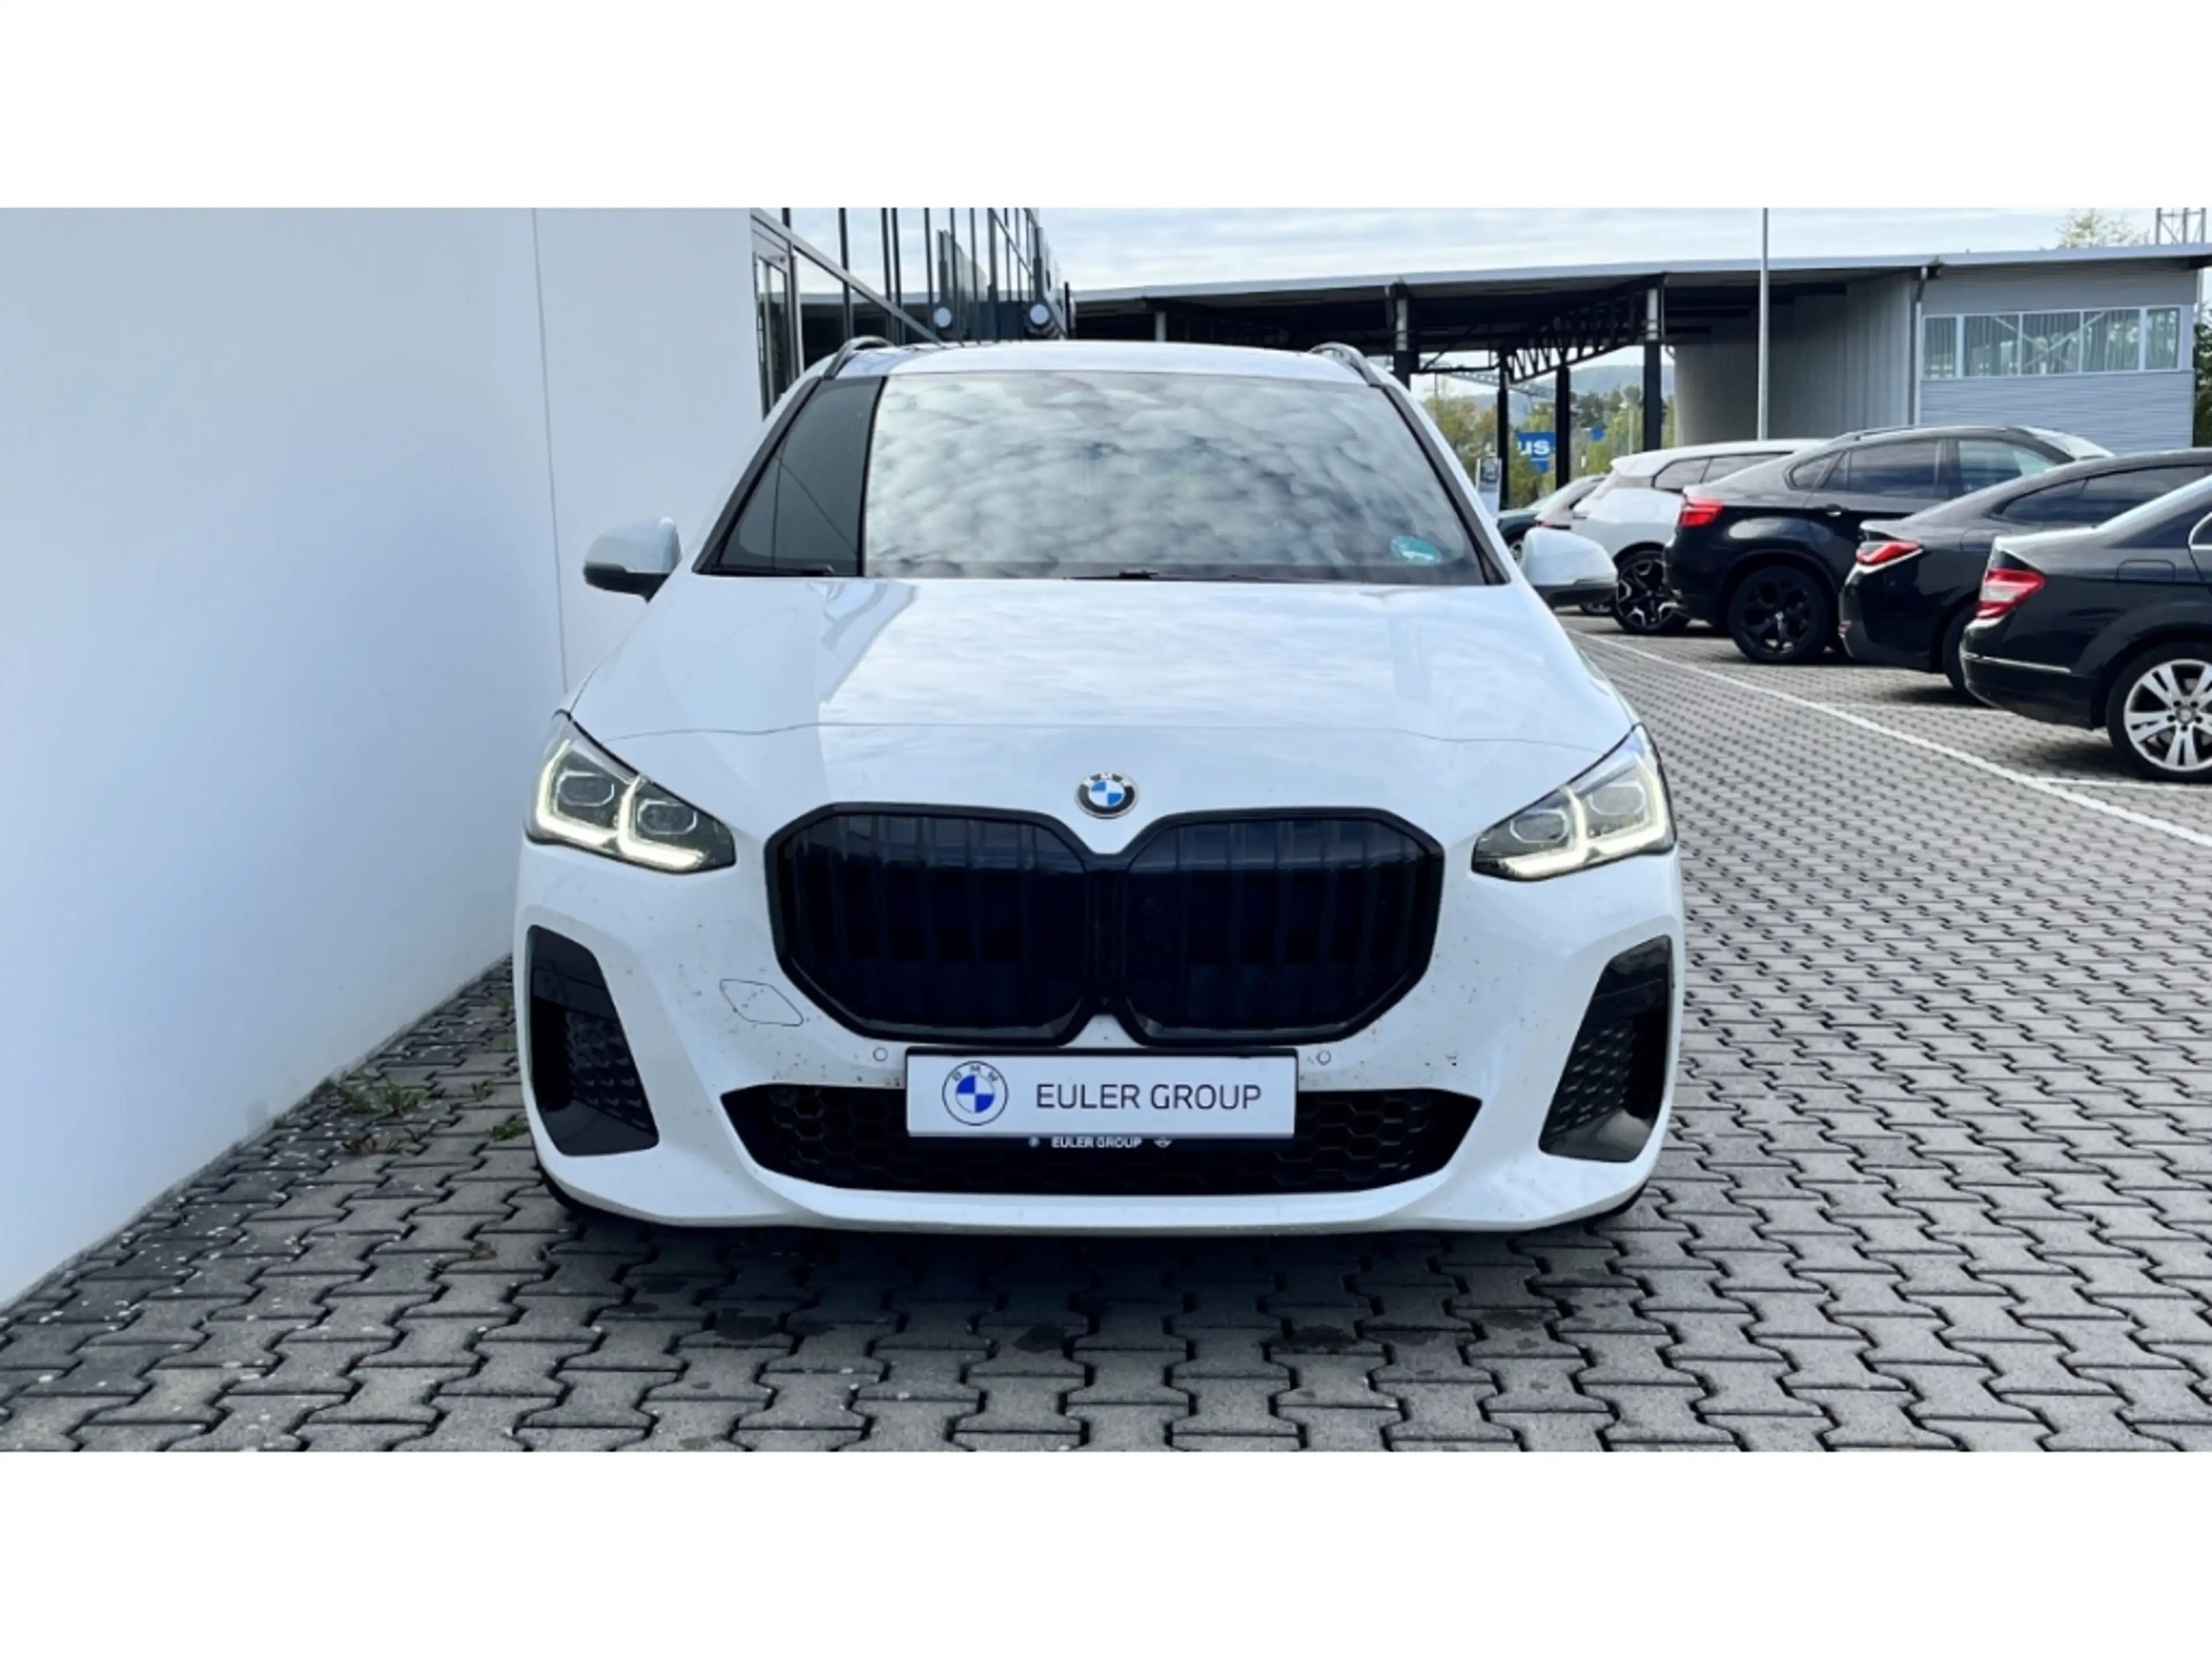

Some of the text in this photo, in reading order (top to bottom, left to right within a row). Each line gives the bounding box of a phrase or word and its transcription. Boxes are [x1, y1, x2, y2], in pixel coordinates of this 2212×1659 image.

[1036, 1084, 1262, 1109] EULER GROUP
[1051, 1136, 1142, 1148] EULER GROUP
